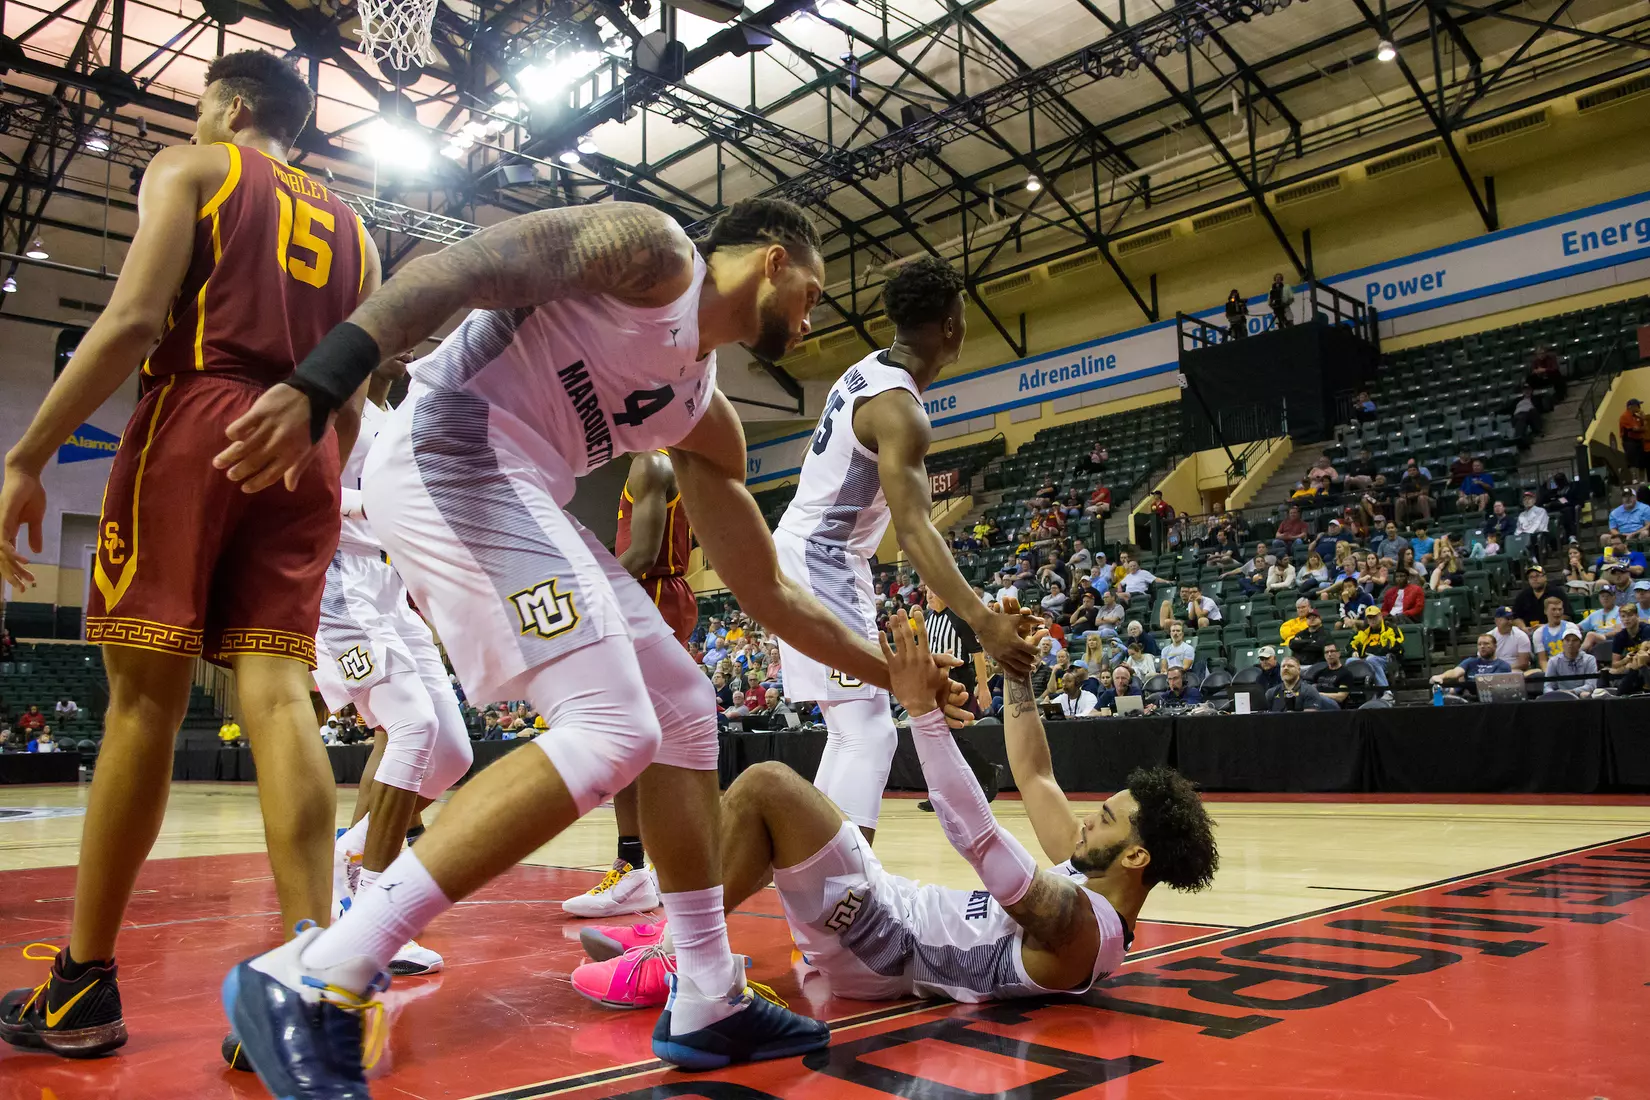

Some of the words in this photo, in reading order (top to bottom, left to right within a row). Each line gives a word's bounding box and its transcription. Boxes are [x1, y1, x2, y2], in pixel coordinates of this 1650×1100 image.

[275, 187, 336, 290] 15
[1562, 216, 1650, 257] Energ
[1366, 269, 1447, 305] Power
[1018, 354, 1117, 392] Adrenaline
[612, 384, 675, 428] 4
[65, 434, 118, 452] Alamo
[506, 576, 582, 640] MU
[336, 644, 375, 682] MU
